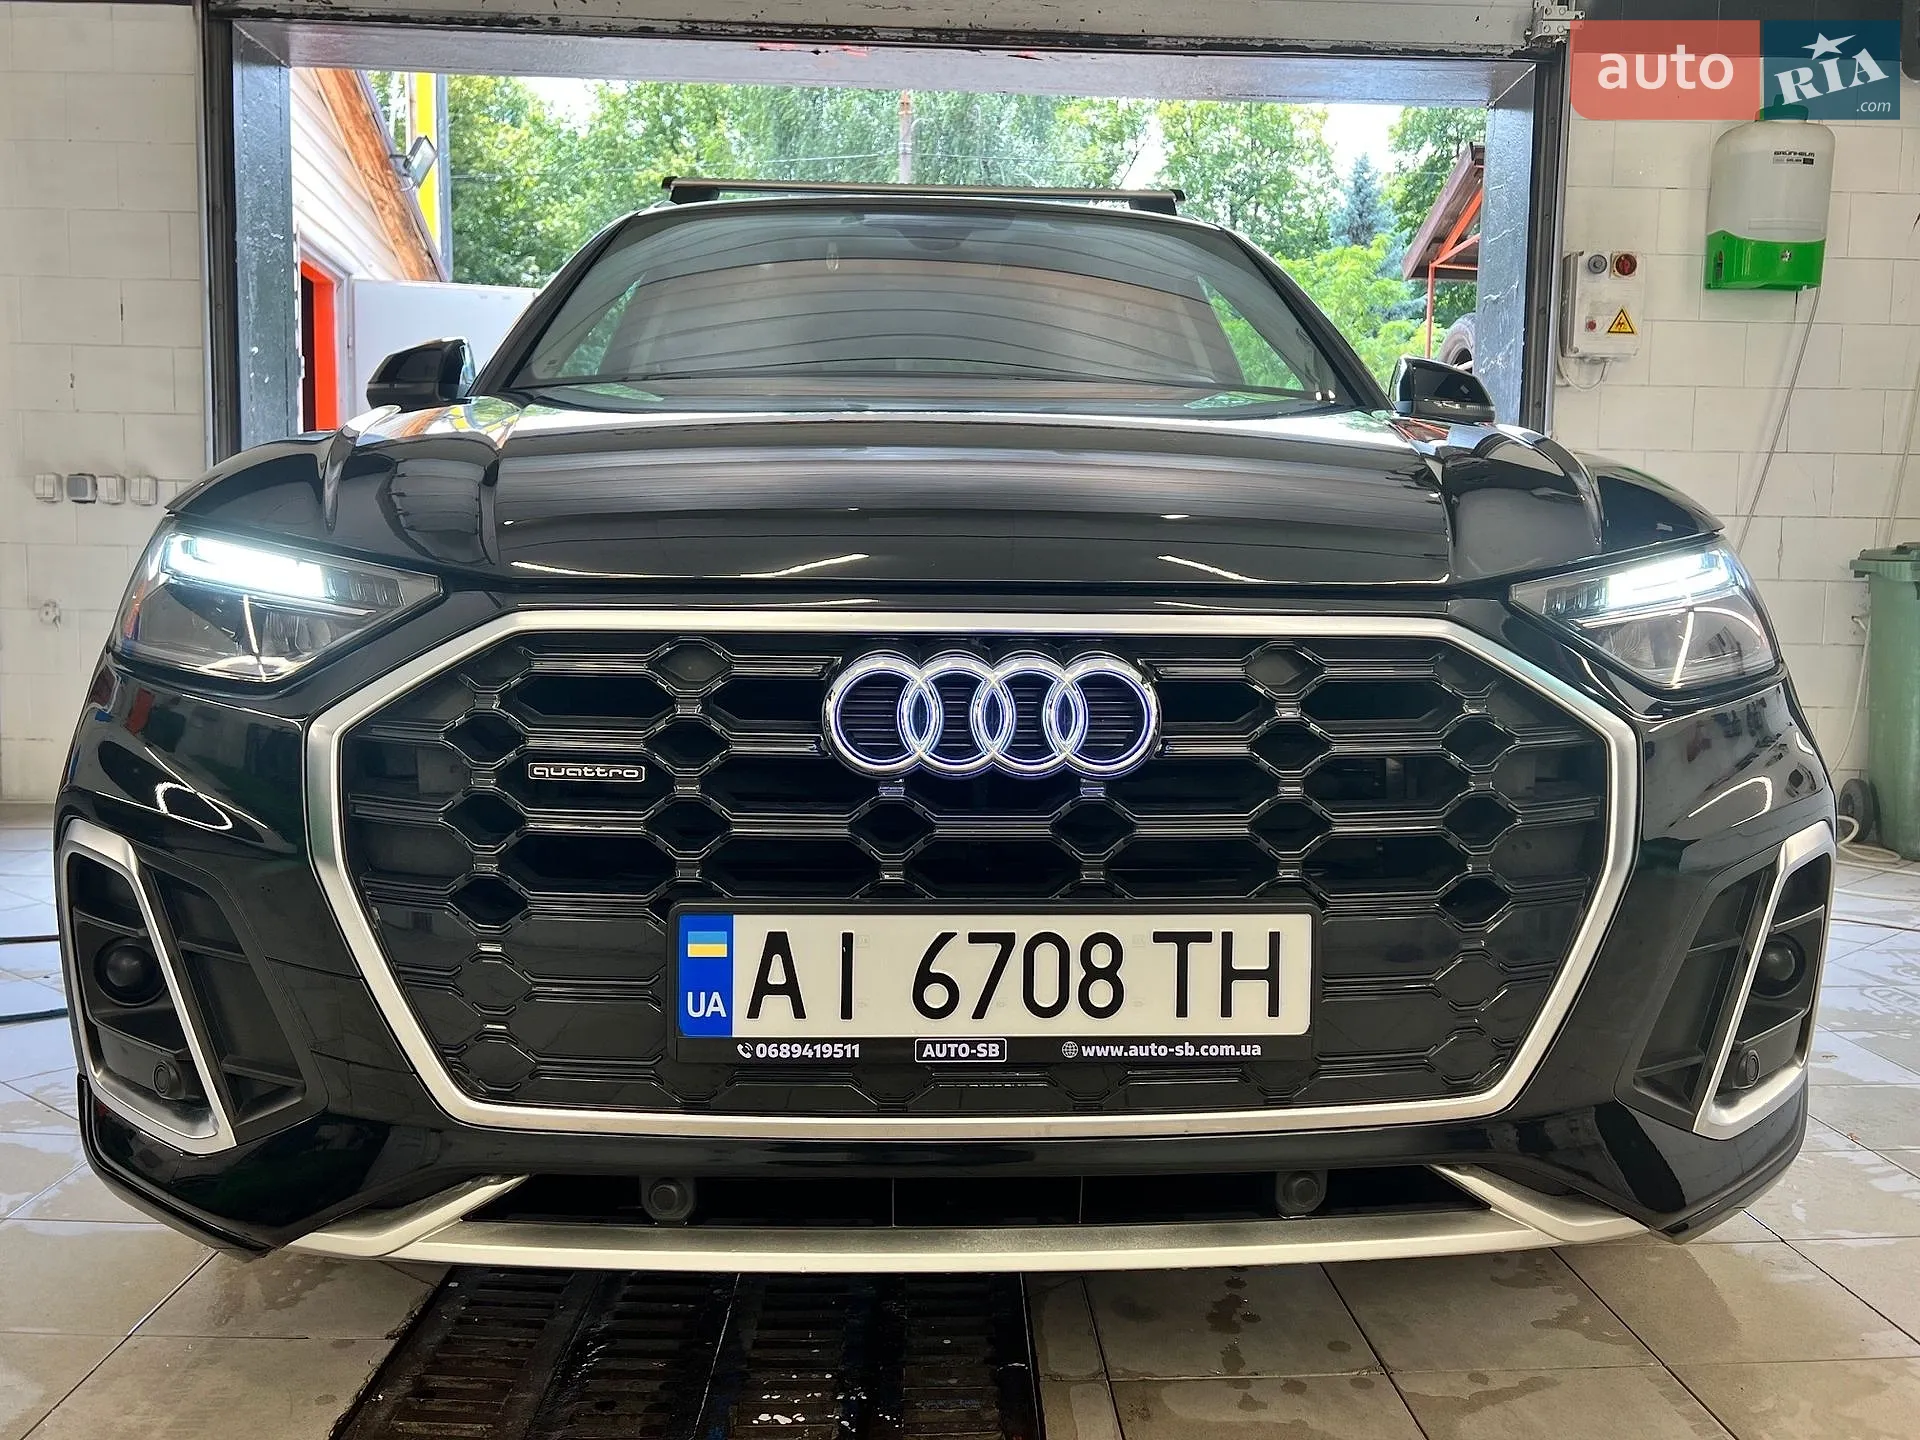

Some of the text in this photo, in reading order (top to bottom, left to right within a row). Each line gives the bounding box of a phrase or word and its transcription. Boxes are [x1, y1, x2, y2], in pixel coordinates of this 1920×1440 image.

[533, 766, 640, 778] quattro
[746, 931, 1281, 1020] AI 6708 TH
[687, 991, 727, 1018] UA
[755, 1042, 1262, 1059] 0689419511 AUTO-SB www.auto-sb.com.ua
